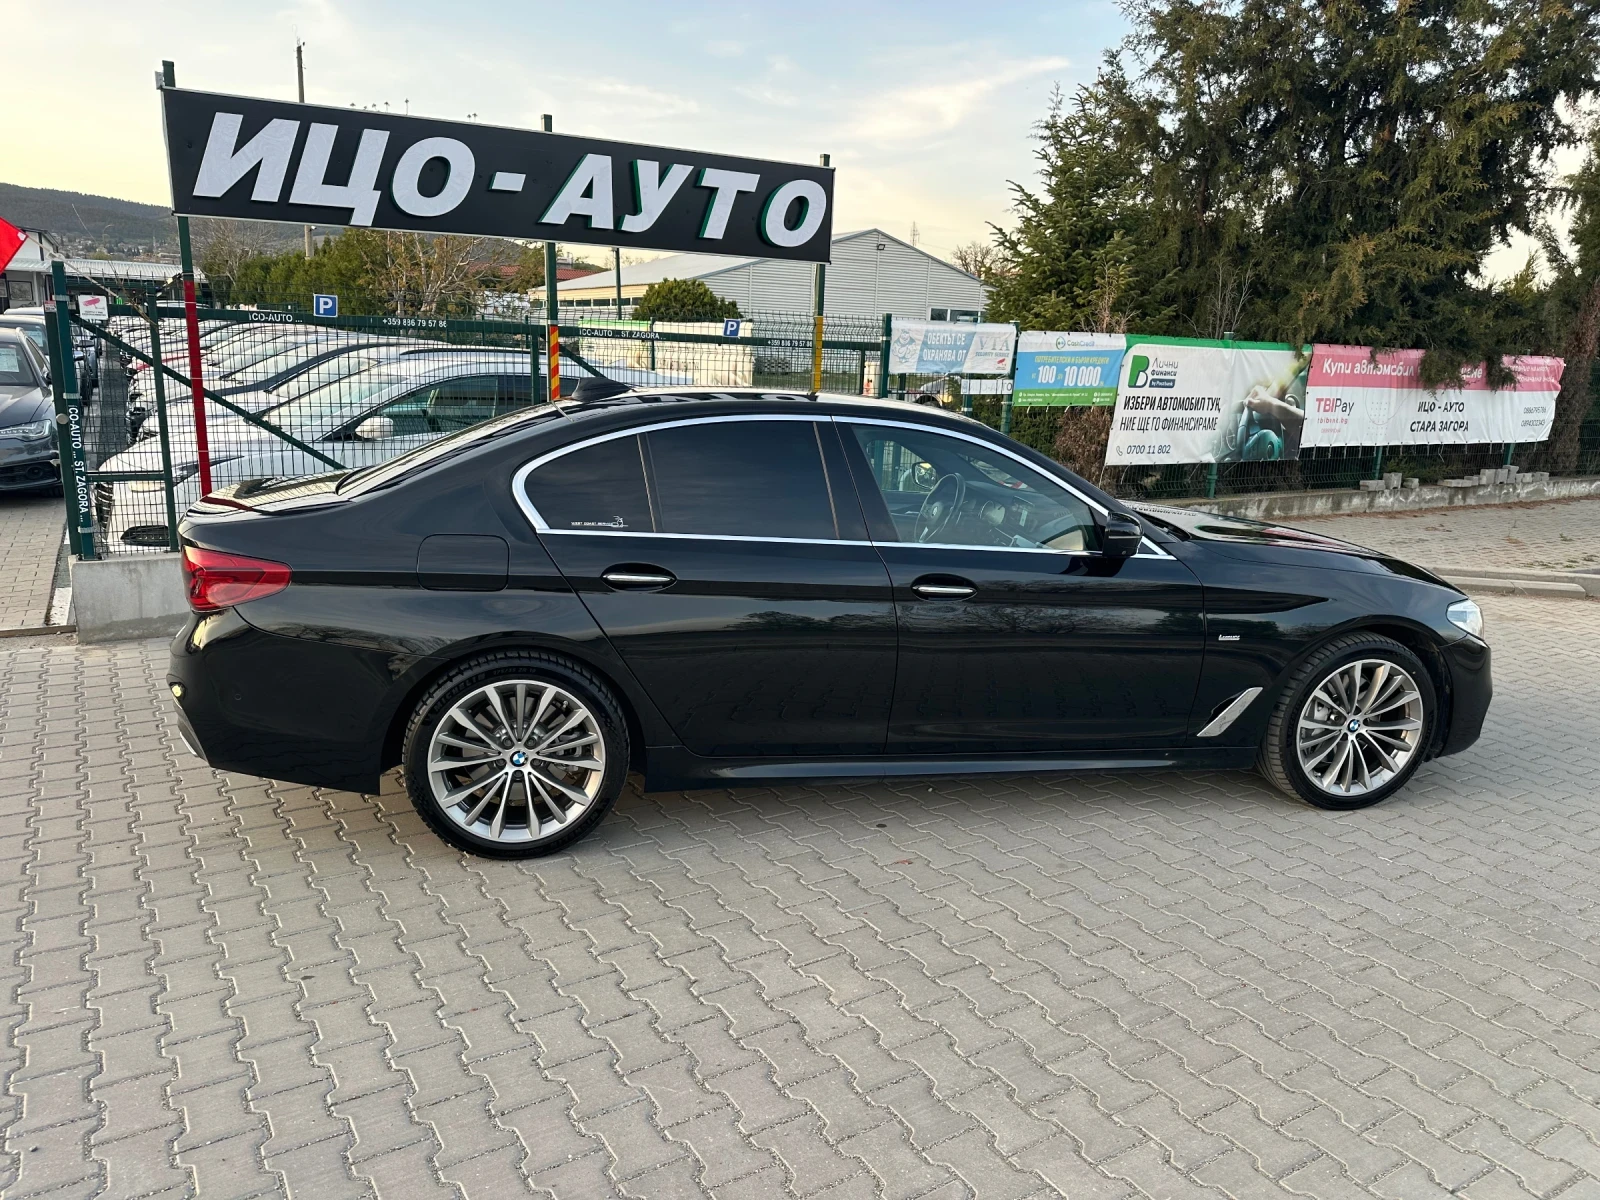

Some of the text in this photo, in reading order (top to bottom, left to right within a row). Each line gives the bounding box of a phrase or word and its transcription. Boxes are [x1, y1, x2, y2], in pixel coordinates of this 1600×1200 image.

[193, 112, 475, 227] ИЦО
[537, 153, 827, 248] АУТО
[319, 298, 332, 314] P
[249, 312, 293, 323] ICO-AUTO
[382, 318, 401, 326] +359
[417, 319, 426, 327] 79
[428, 319, 437, 327] 57
[632, 331, 660, 339] ZAGORA
[727, 321, 737, 335] P
[927, 332, 966, 345] ОБЕКТЪТ СЕ
[923, 349, 967, 361] ОХРАНЯВА ОТ
[1152, 358, 1179, 369] Лични
[1323, 358, 1352, 376] Купи
[1038, 365, 1057, 383] 100
[1123, 396, 1157, 411] ИЗБЕРИ
[1156, 397, 1205, 411] АВТОМОБИЛ
[1316, 398, 1355, 416] TBIPay
[1417, 402, 1436, 414] ИЦО
[1443, 402, 1465, 413] АУТО
[68, 405, 82, 449] ICO-AUTO
[1120, 416, 1218, 433] НИЕ ЩЕ ГО ФИНАНСИРАМЕ
[1410, 420, 1469, 432] СТАРА ЗАГОРА
[1126, 445, 1171, 454] 0700 11 802
[74, 460, 85, 478] ST.
[75, 475, 89, 515] ZAGORA
[433, 673, 486, 712] MICHELIN
